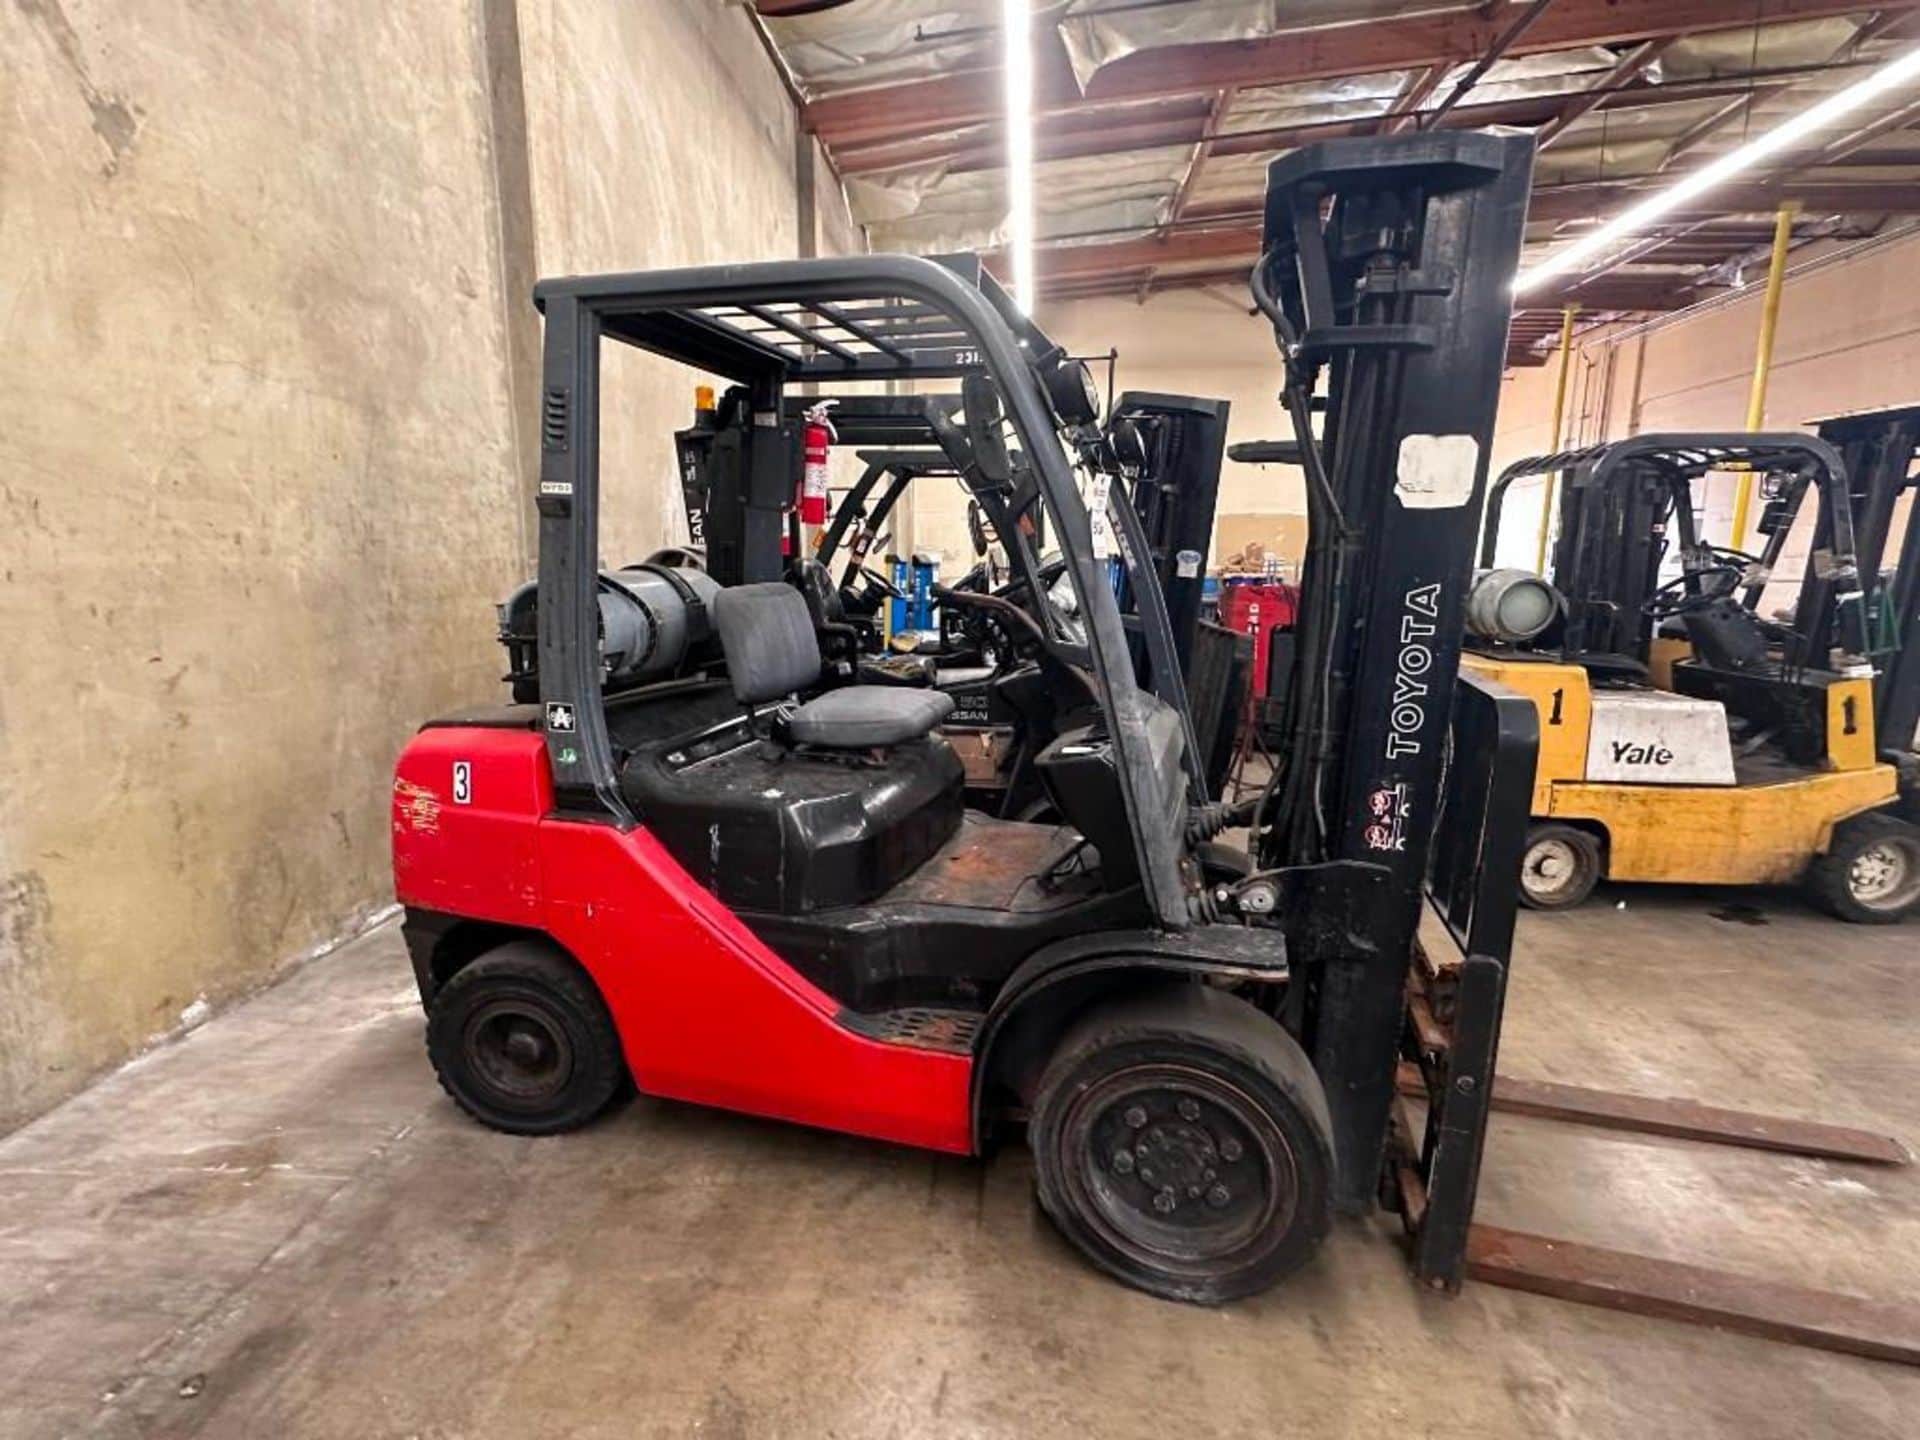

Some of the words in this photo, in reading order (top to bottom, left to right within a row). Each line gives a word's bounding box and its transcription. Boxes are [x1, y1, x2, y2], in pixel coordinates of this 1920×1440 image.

[1386, 583, 1441, 760] TOYOTA
[947, 711, 988, 721] SSAN
[1549, 688, 1563, 725] 1
[1842, 695, 1857, 735] 1
[1612, 741, 1674, 766] Yale
[456, 764, 468, 801] 3
